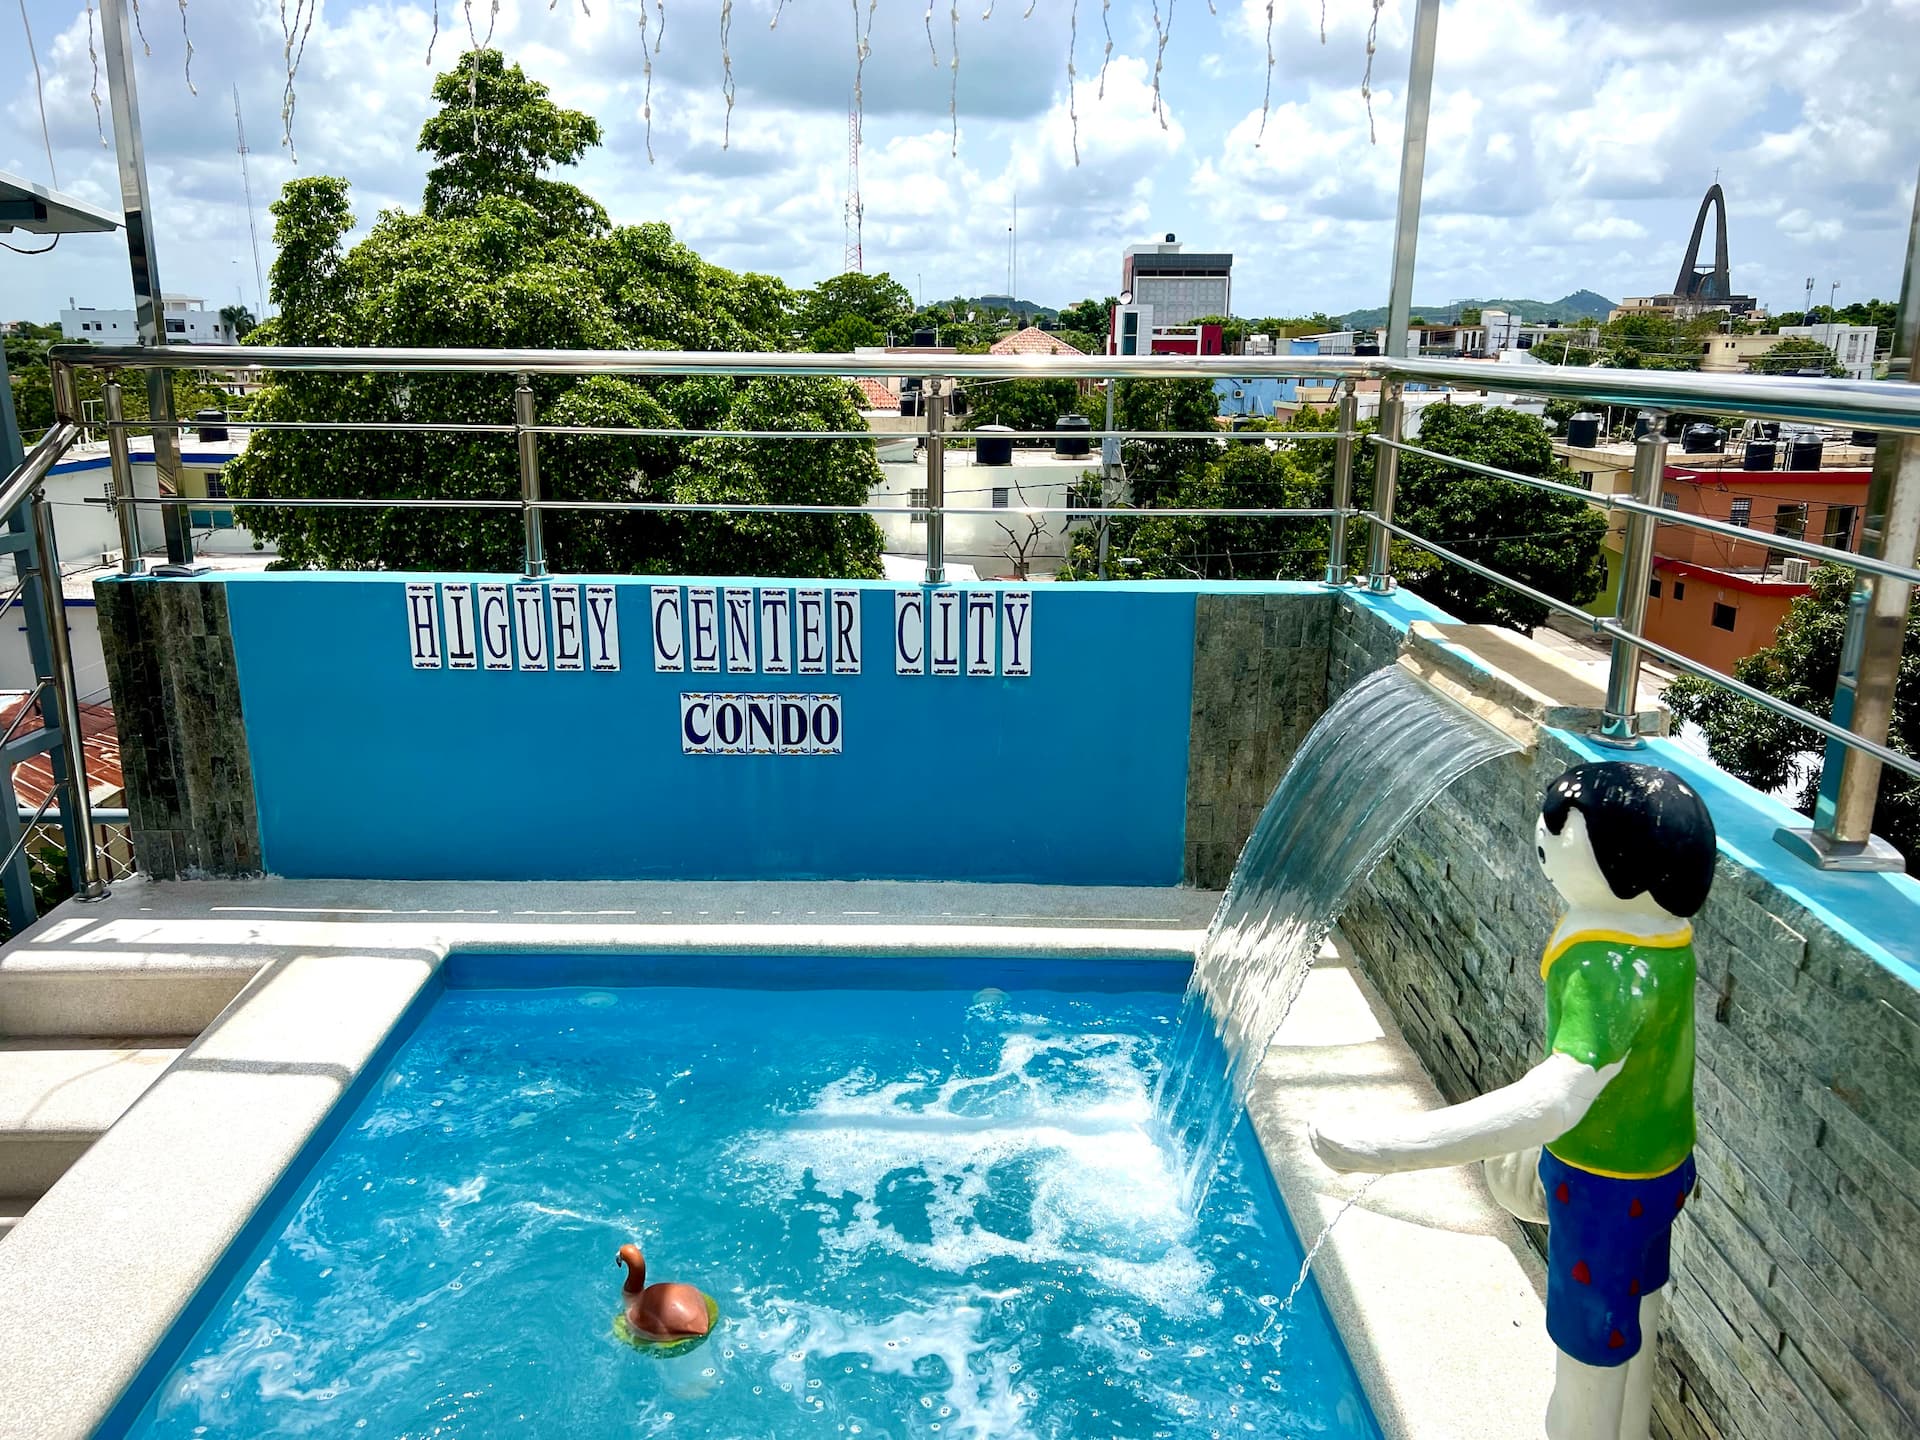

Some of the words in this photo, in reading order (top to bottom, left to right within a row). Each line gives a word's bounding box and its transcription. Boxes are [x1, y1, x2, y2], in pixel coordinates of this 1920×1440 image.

[409, 595, 613, 661] HIGUEY
[898, 601, 1029, 666] CITY
[684, 702, 839, 745] CONDO
